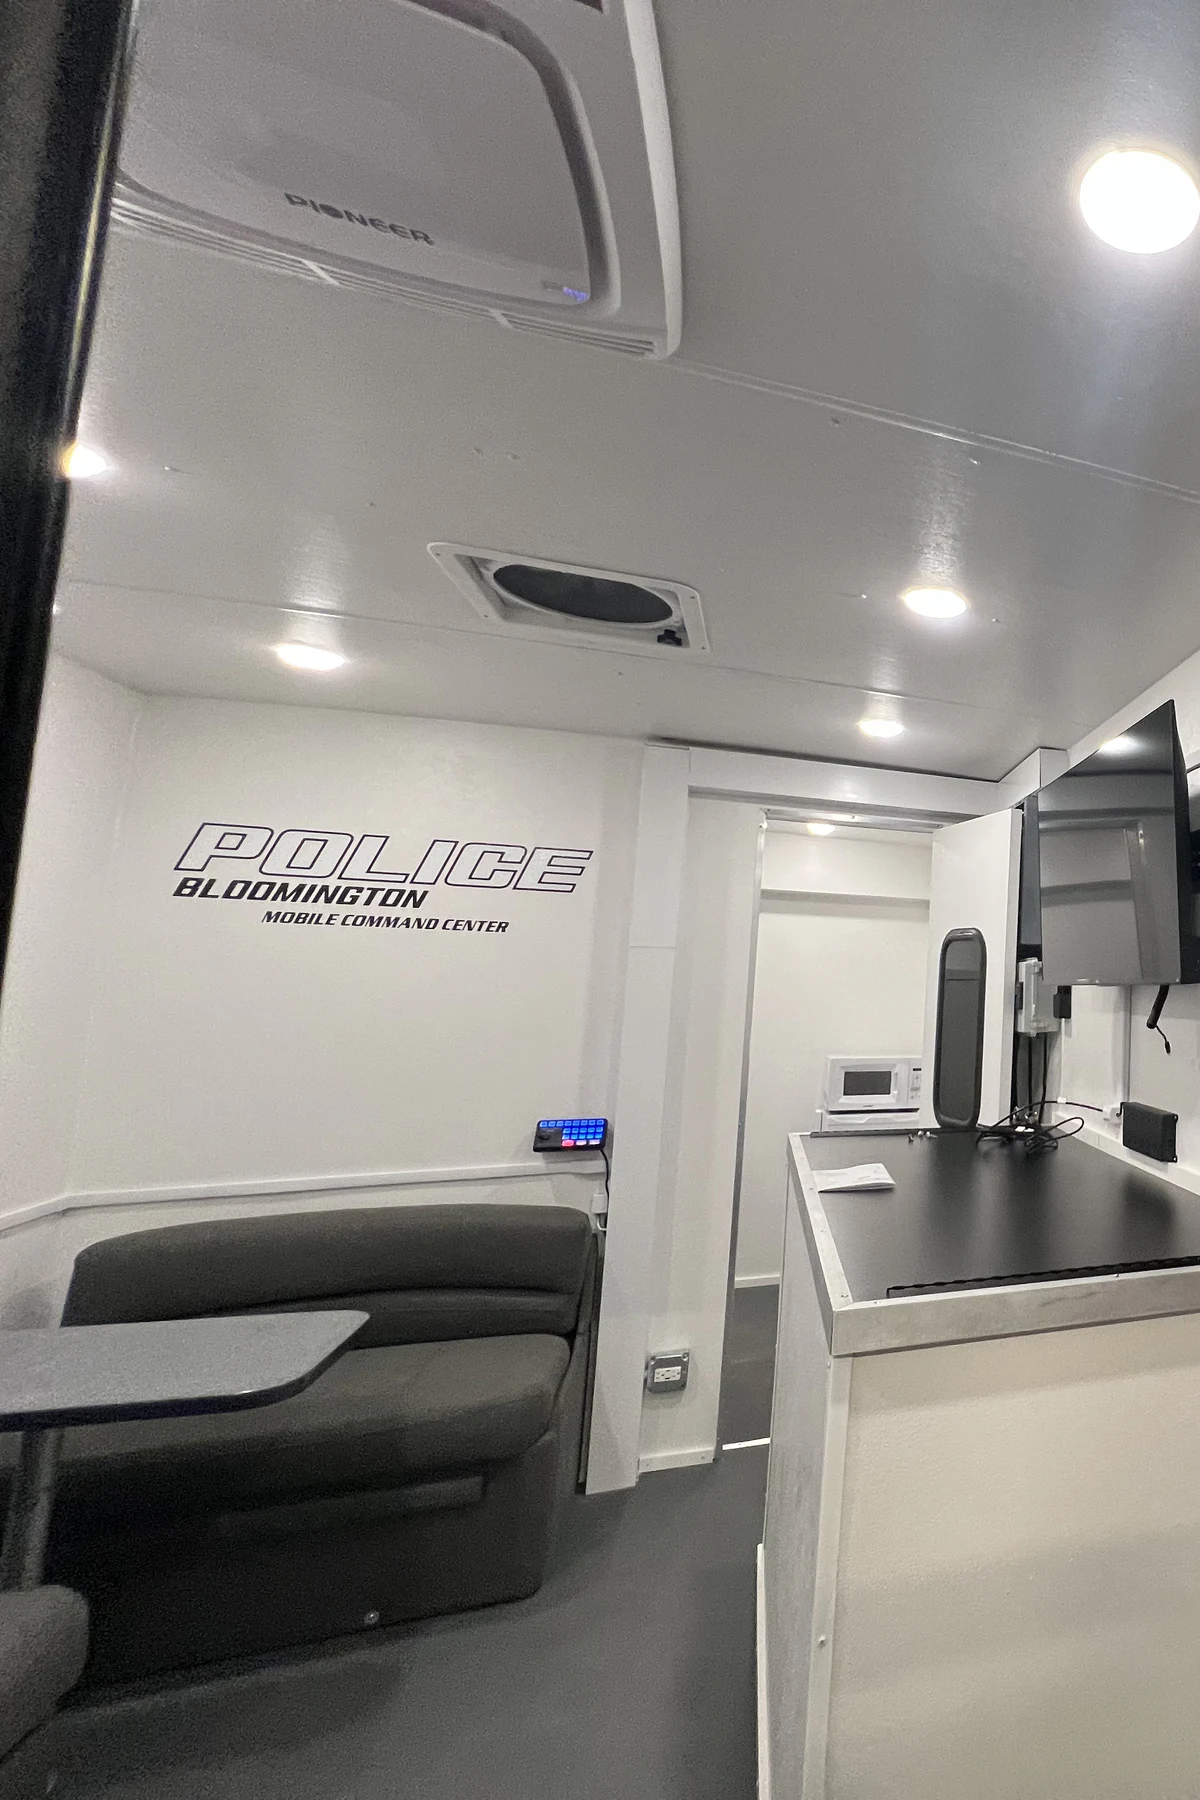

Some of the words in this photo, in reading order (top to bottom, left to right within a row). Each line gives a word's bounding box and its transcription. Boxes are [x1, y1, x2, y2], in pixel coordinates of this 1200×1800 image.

[284, 192, 436, 246] PIONEER
[173, 822, 595, 893] POLICE
[172, 876, 429, 909] BLOOMINGTON
[261, 910, 340, 926] MOBILE
[340, 914, 440, 931] COMMAND
[441, 918, 510, 933] CENTER
